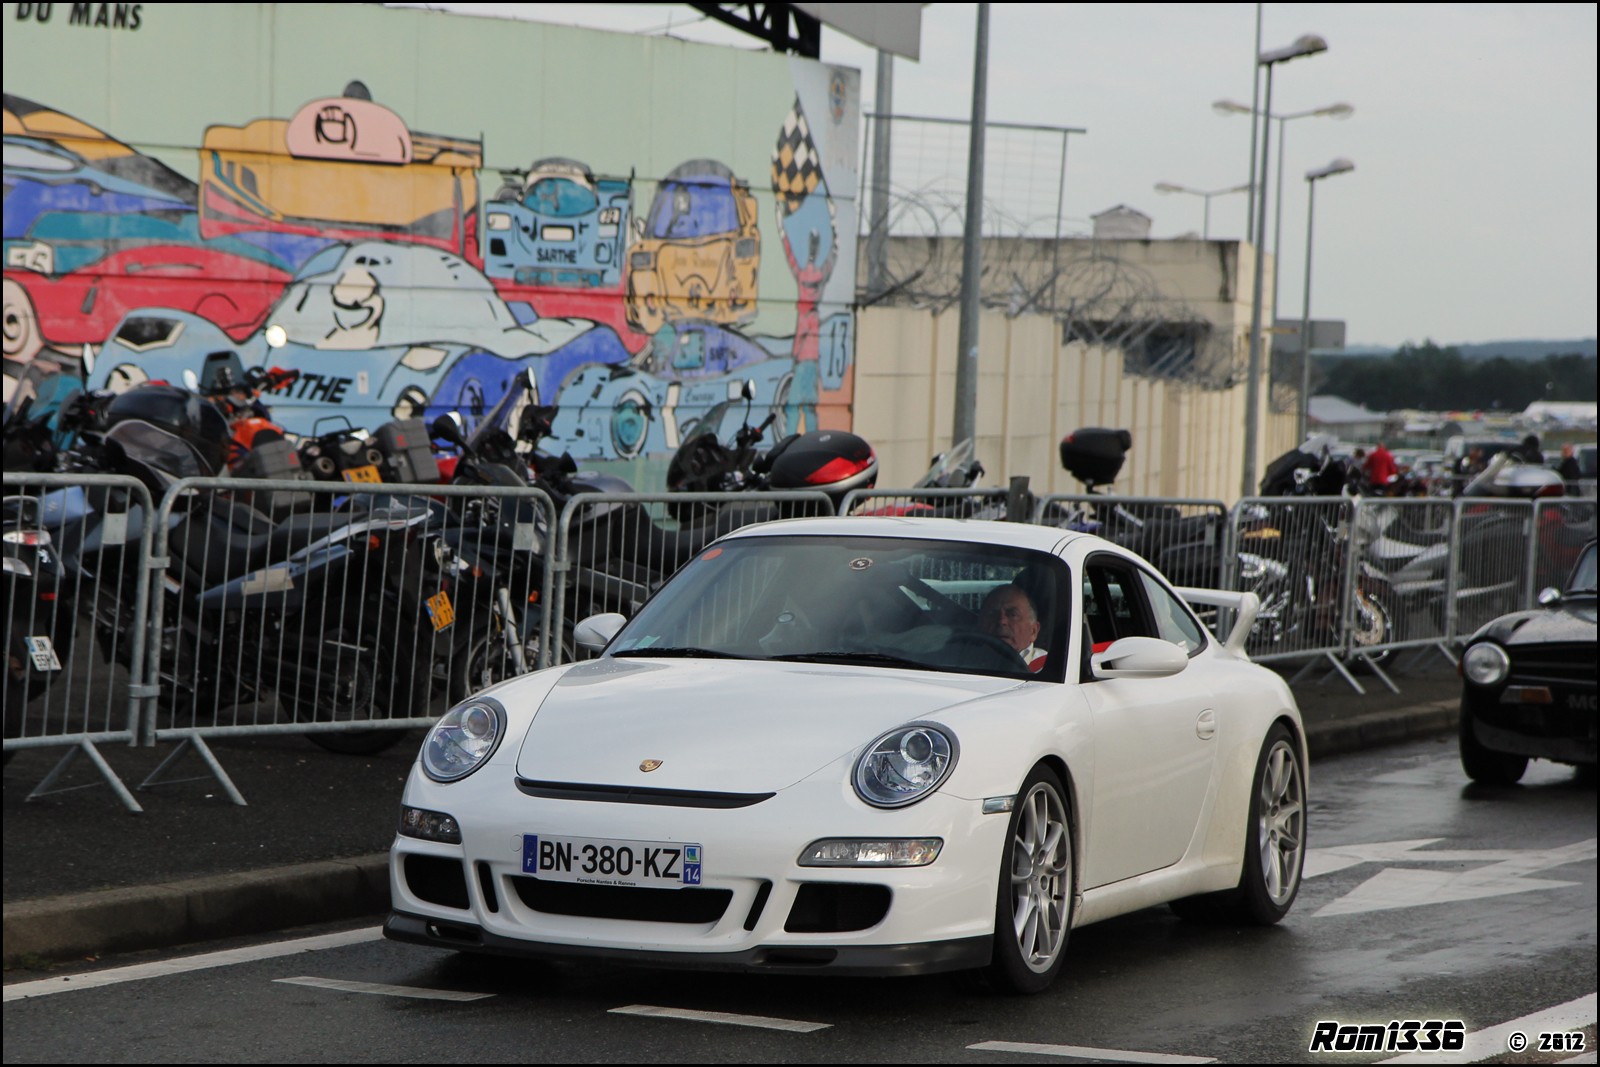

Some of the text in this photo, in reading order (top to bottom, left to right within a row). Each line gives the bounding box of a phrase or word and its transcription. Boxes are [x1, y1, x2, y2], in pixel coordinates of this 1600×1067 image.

[16, 3, 143, 30] DU MANS
[537, 247, 577, 264] SARTHE
[827, 321, 848, 378] 13
[526, 841, 701, 883] F BN-380-KZ 14
